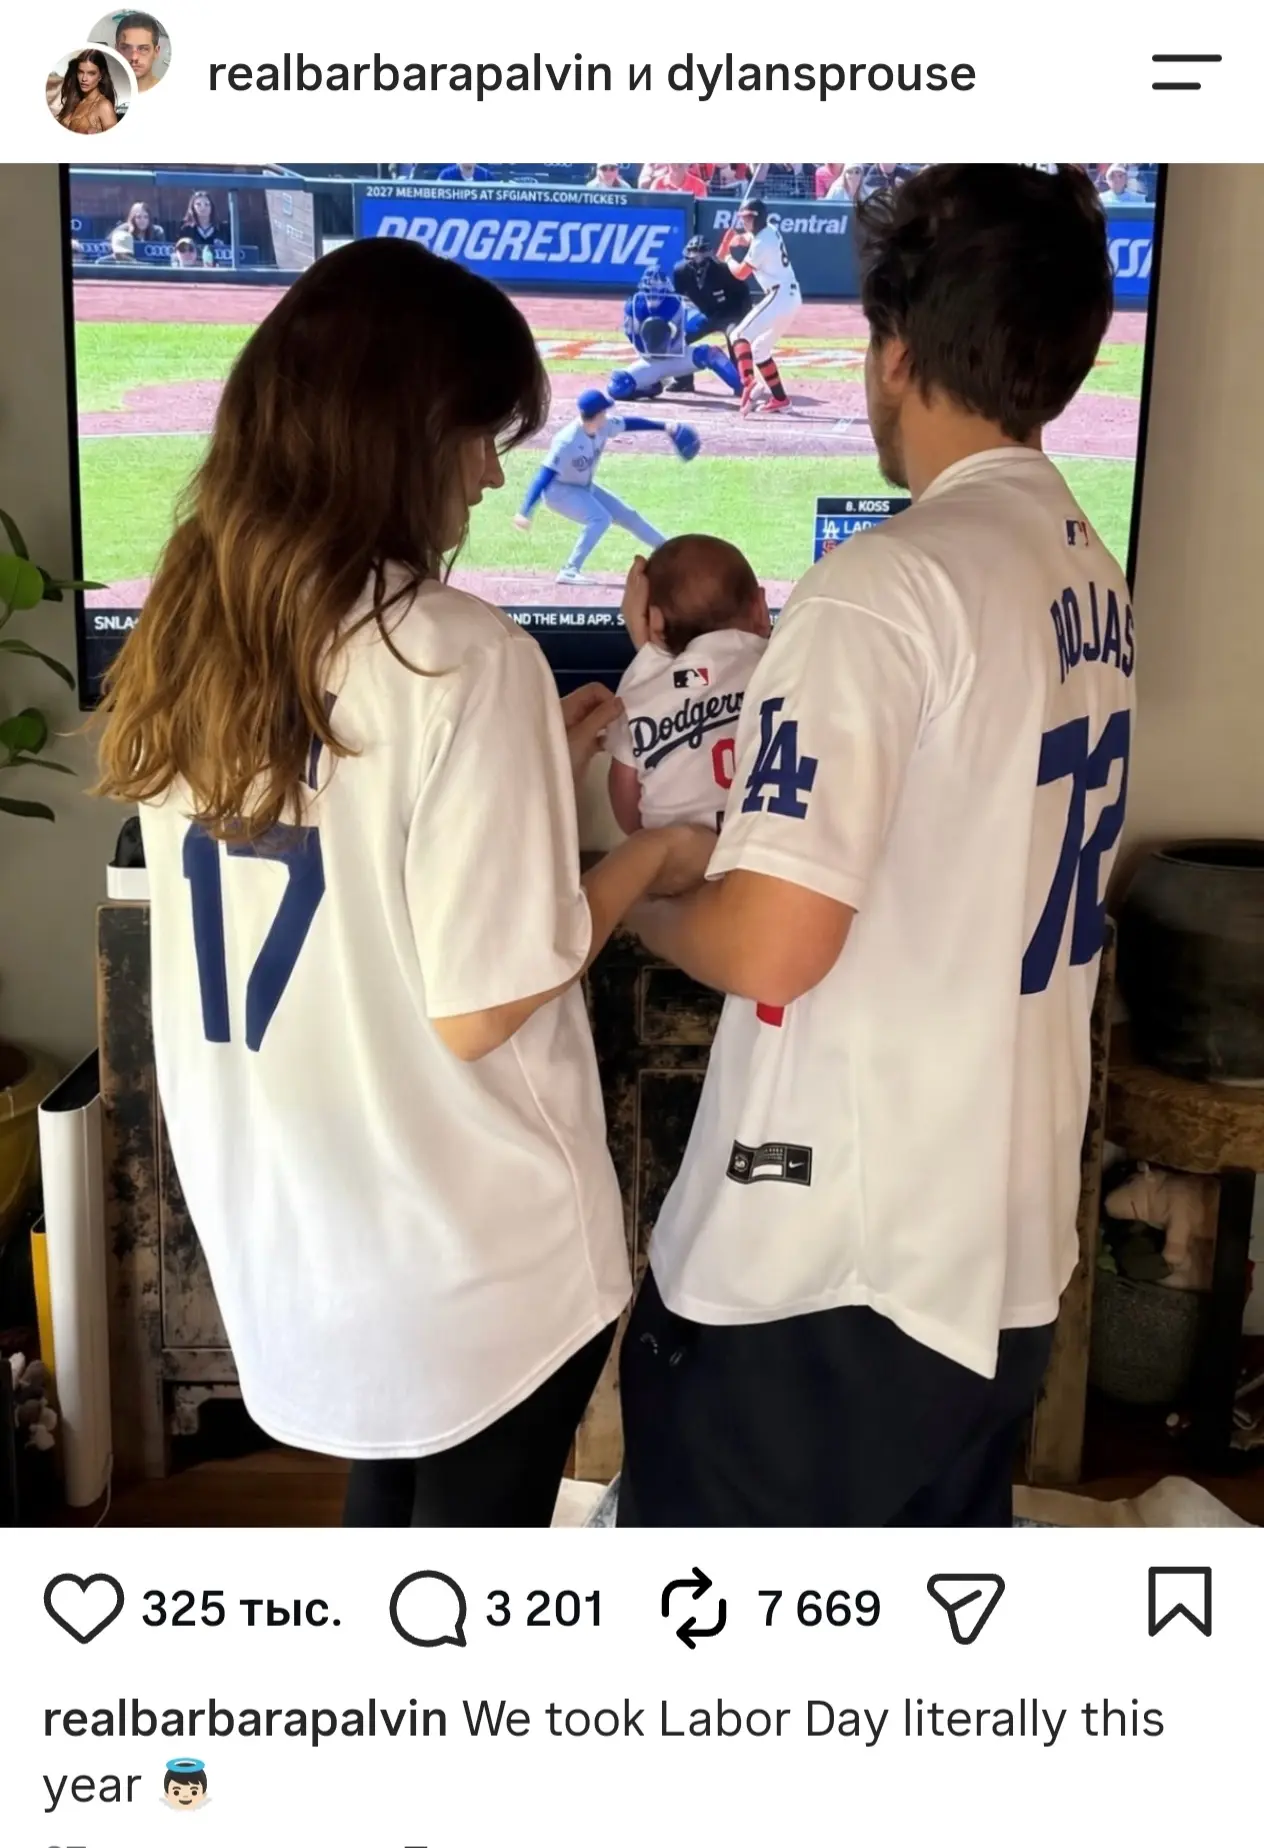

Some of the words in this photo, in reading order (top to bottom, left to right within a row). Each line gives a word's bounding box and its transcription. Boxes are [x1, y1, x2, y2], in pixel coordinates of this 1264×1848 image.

[366, 186, 393, 199] 2027
[396, 187, 478, 200] MEMBERSHIPS
[479, 189, 494, 200] AT
[496, 189, 628, 206] SFGIANTS.COM/TICKETS
[858, 500, 890, 512] KOSS
[532, 612, 558, 625] THE
[559, 612, 585, 625] MLB
[587, 612, 614, 625] APP.
[1050, 581, 1135, 686] ROJAS
[741, 697, 818, 820] LA
[1020, 709, 1131, 995] 72
[183, 817, 326, 1053] 17
